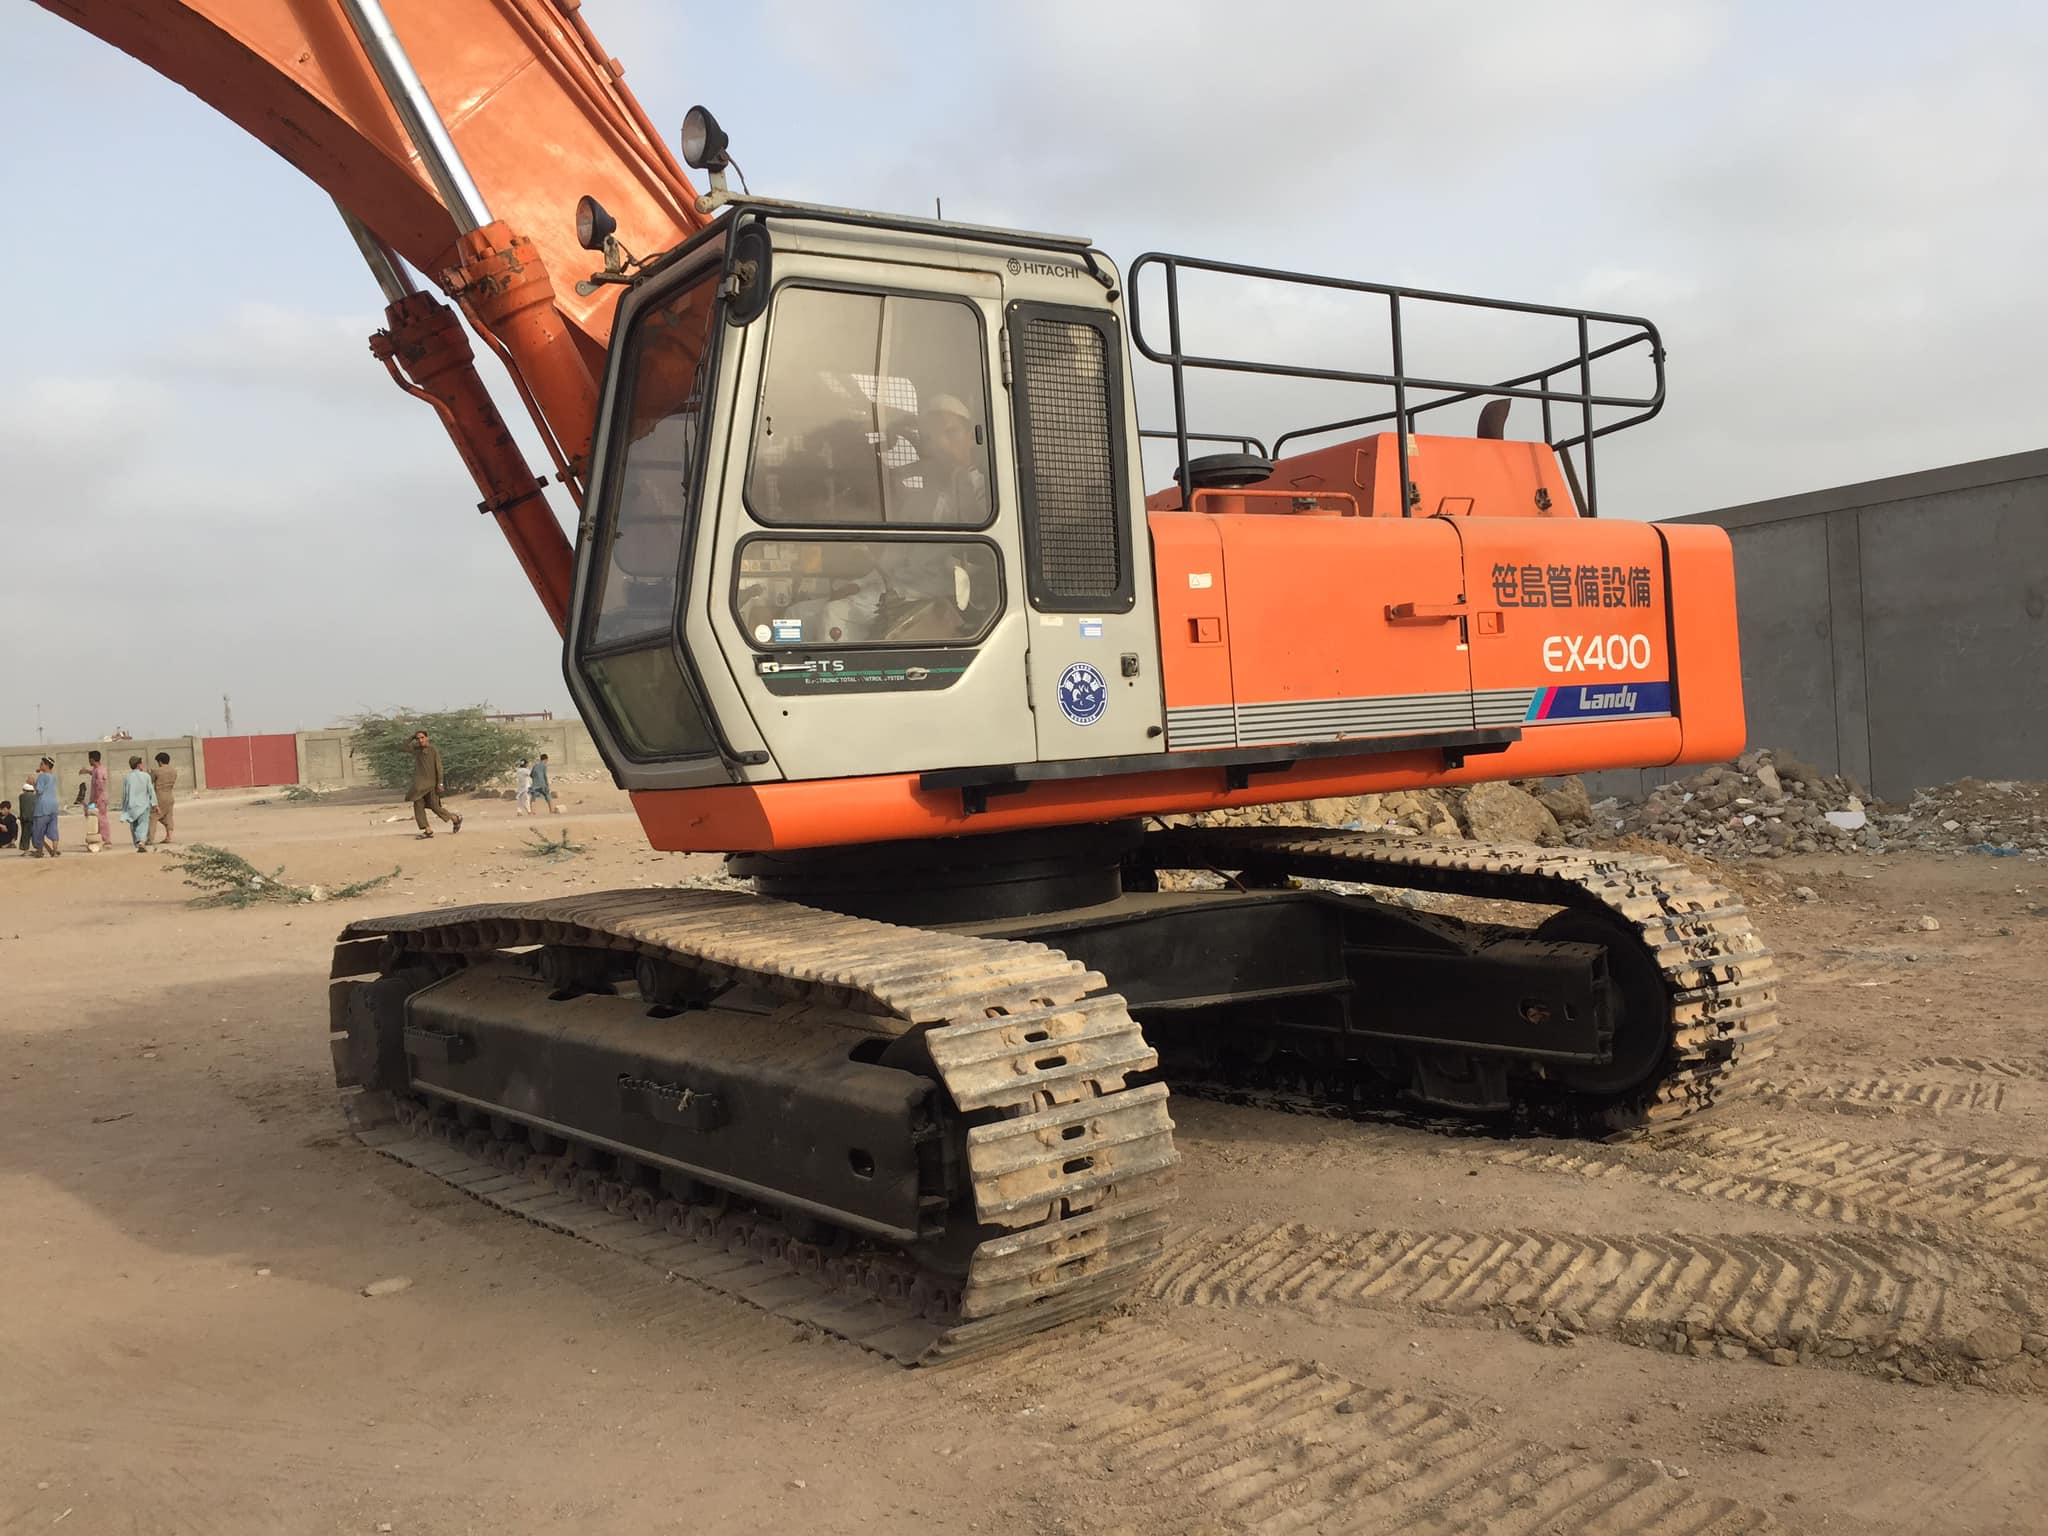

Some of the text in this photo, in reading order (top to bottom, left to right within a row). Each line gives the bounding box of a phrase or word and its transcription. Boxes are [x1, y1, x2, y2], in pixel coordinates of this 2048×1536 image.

[1024, 263, 1079, 279] HITACHI
[1492, 563, 1651, 608] 笹島管備設備
[1542, 633, 1651, 673] EX400
[1579, 685, 1638, 712] Landy
